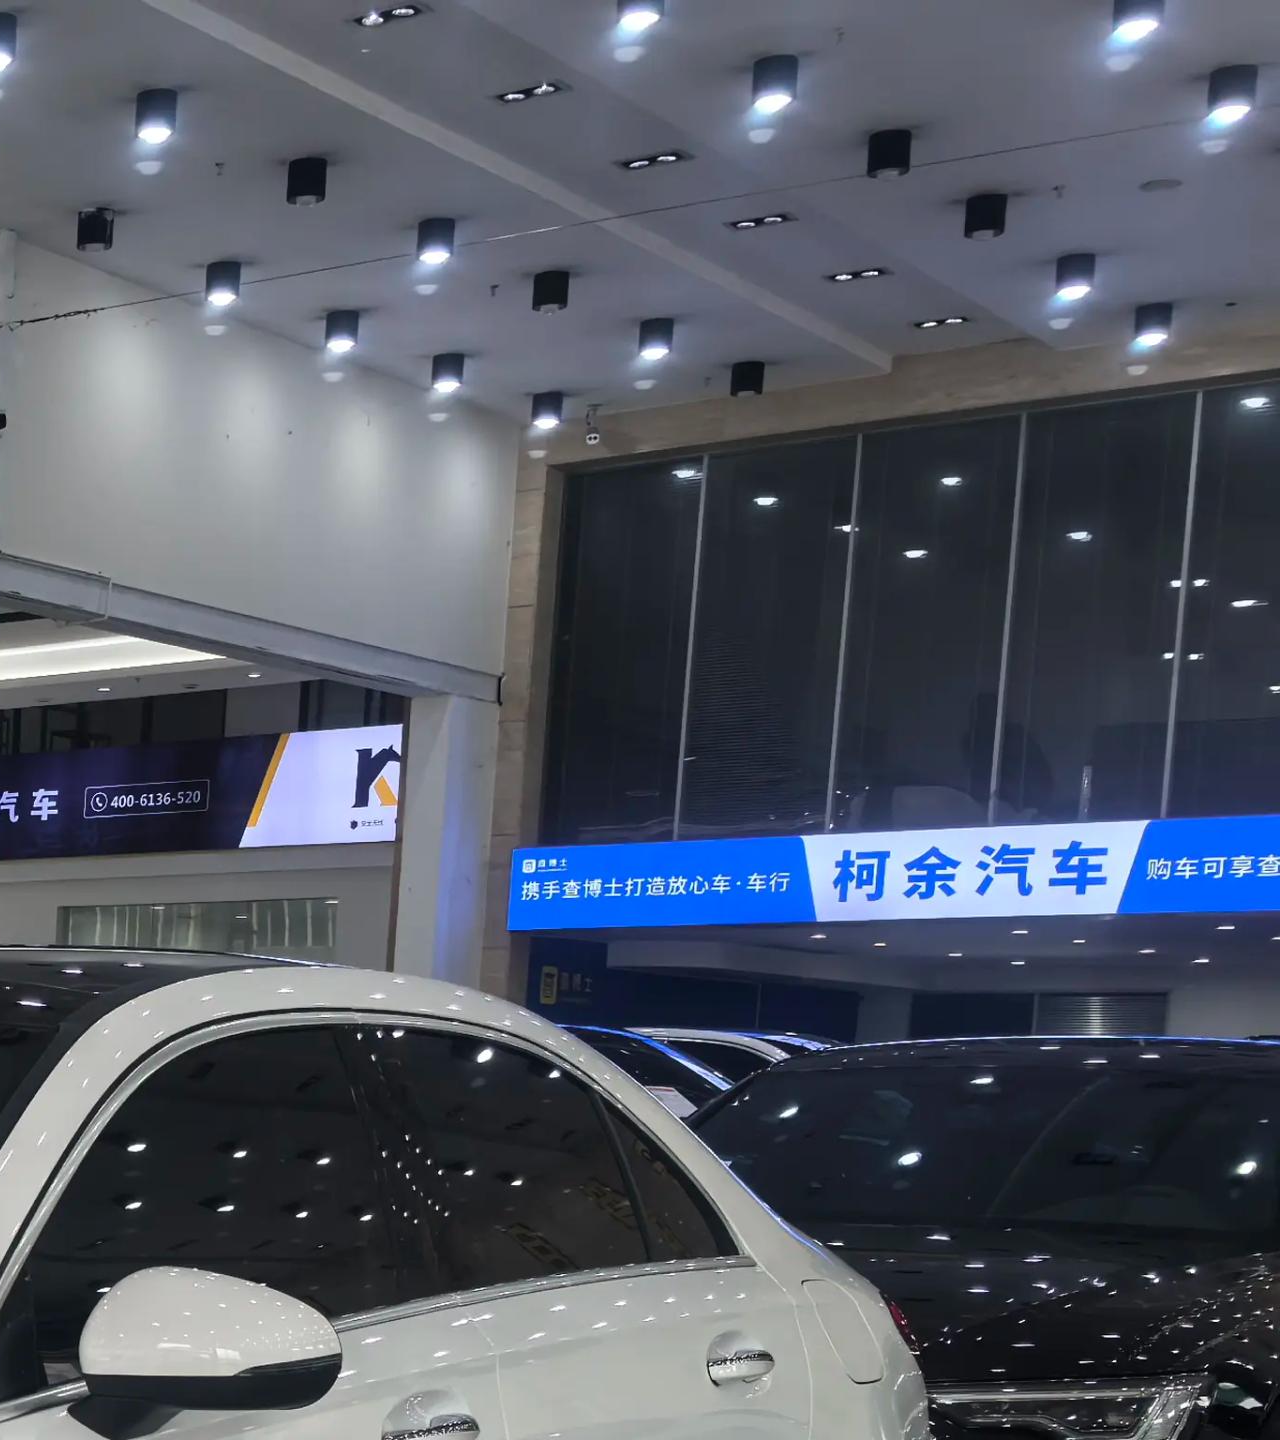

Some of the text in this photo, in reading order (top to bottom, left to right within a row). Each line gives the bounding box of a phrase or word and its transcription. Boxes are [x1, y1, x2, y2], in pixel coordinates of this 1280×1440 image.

[109, 789, 201, 809] 400-6136-520
[832, 840, 1110, 902] 柯余汽车
